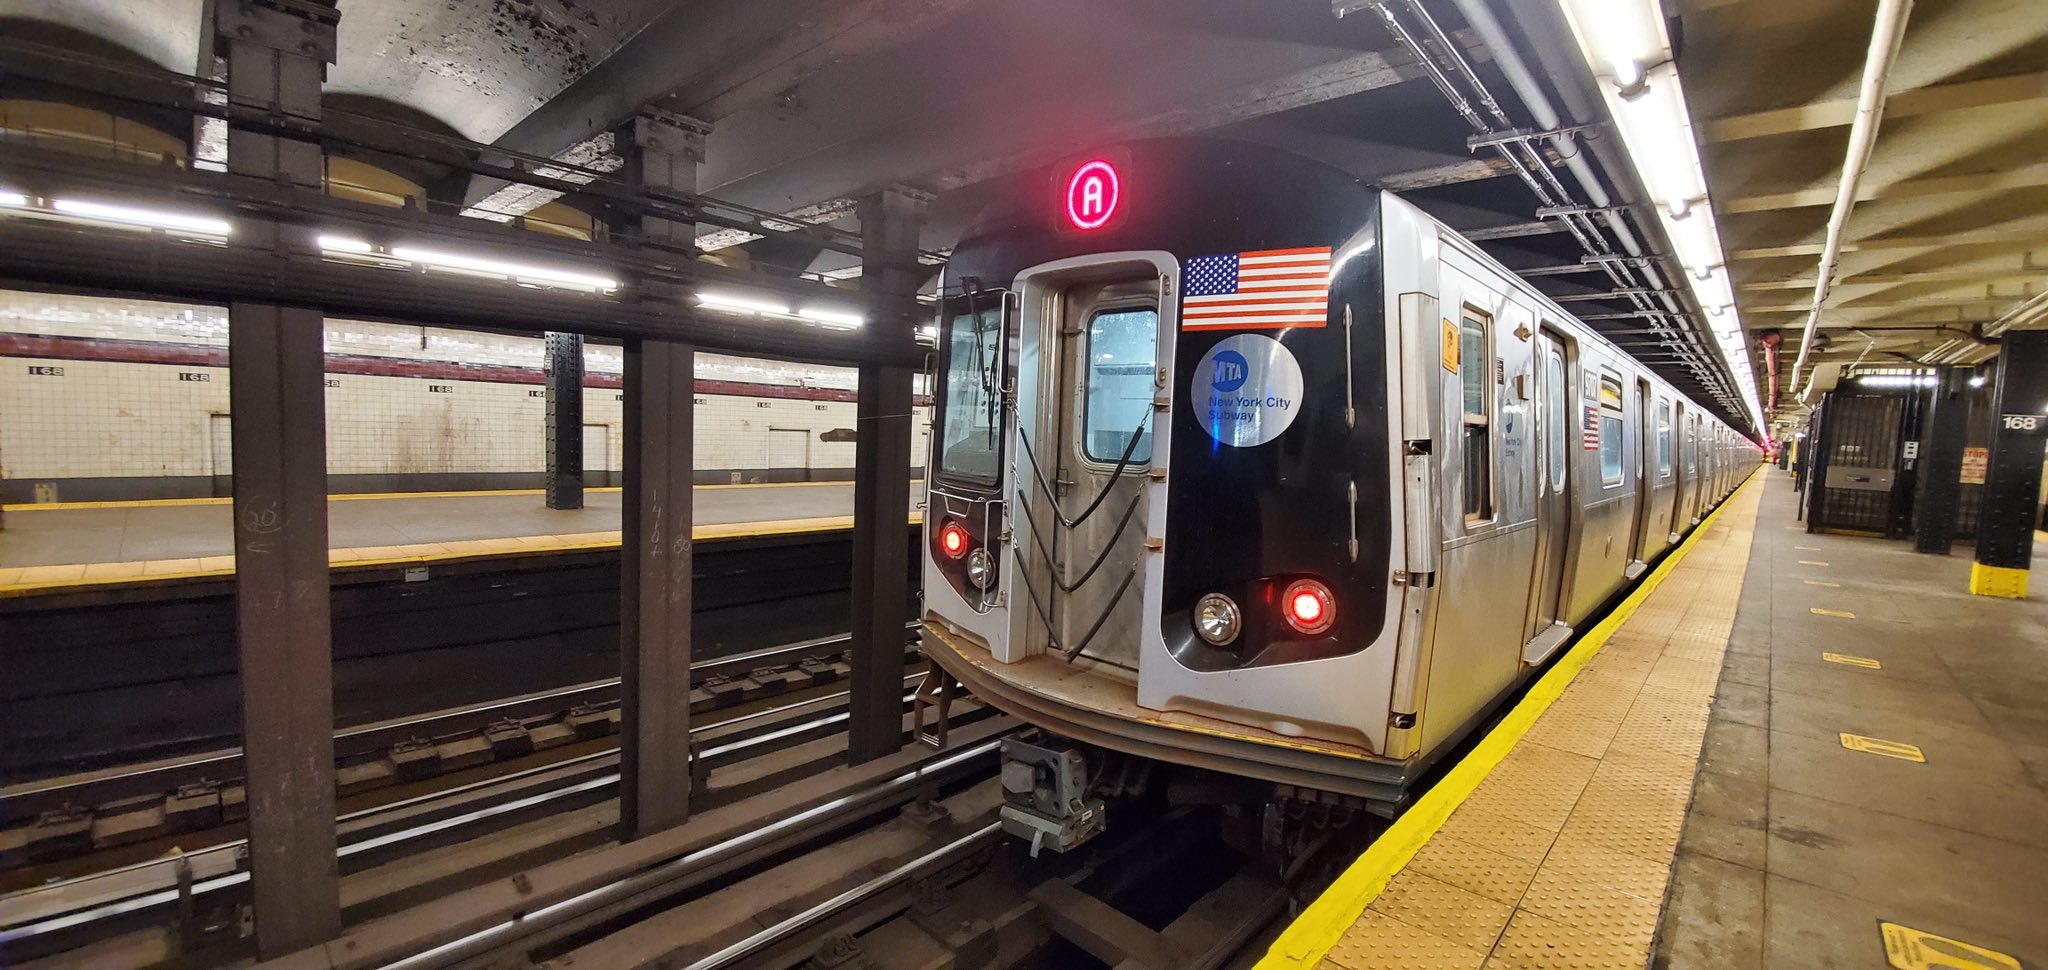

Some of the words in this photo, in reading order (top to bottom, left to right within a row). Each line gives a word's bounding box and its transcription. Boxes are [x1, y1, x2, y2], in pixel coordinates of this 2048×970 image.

[1083, 176, 1102, 216] A
[31, 367, 64, 376] 168
[182, 373, 210, 382] 168
[1211, 359, 1242, 384] MTA
[1208, 396, 1234, 408] New
[1235, 396, 1263, 408] York
[1266, 396, 1291, 411] City
[1208, 409, 1255, 423] Subway
[2002, 416, 2037, 430] 168
